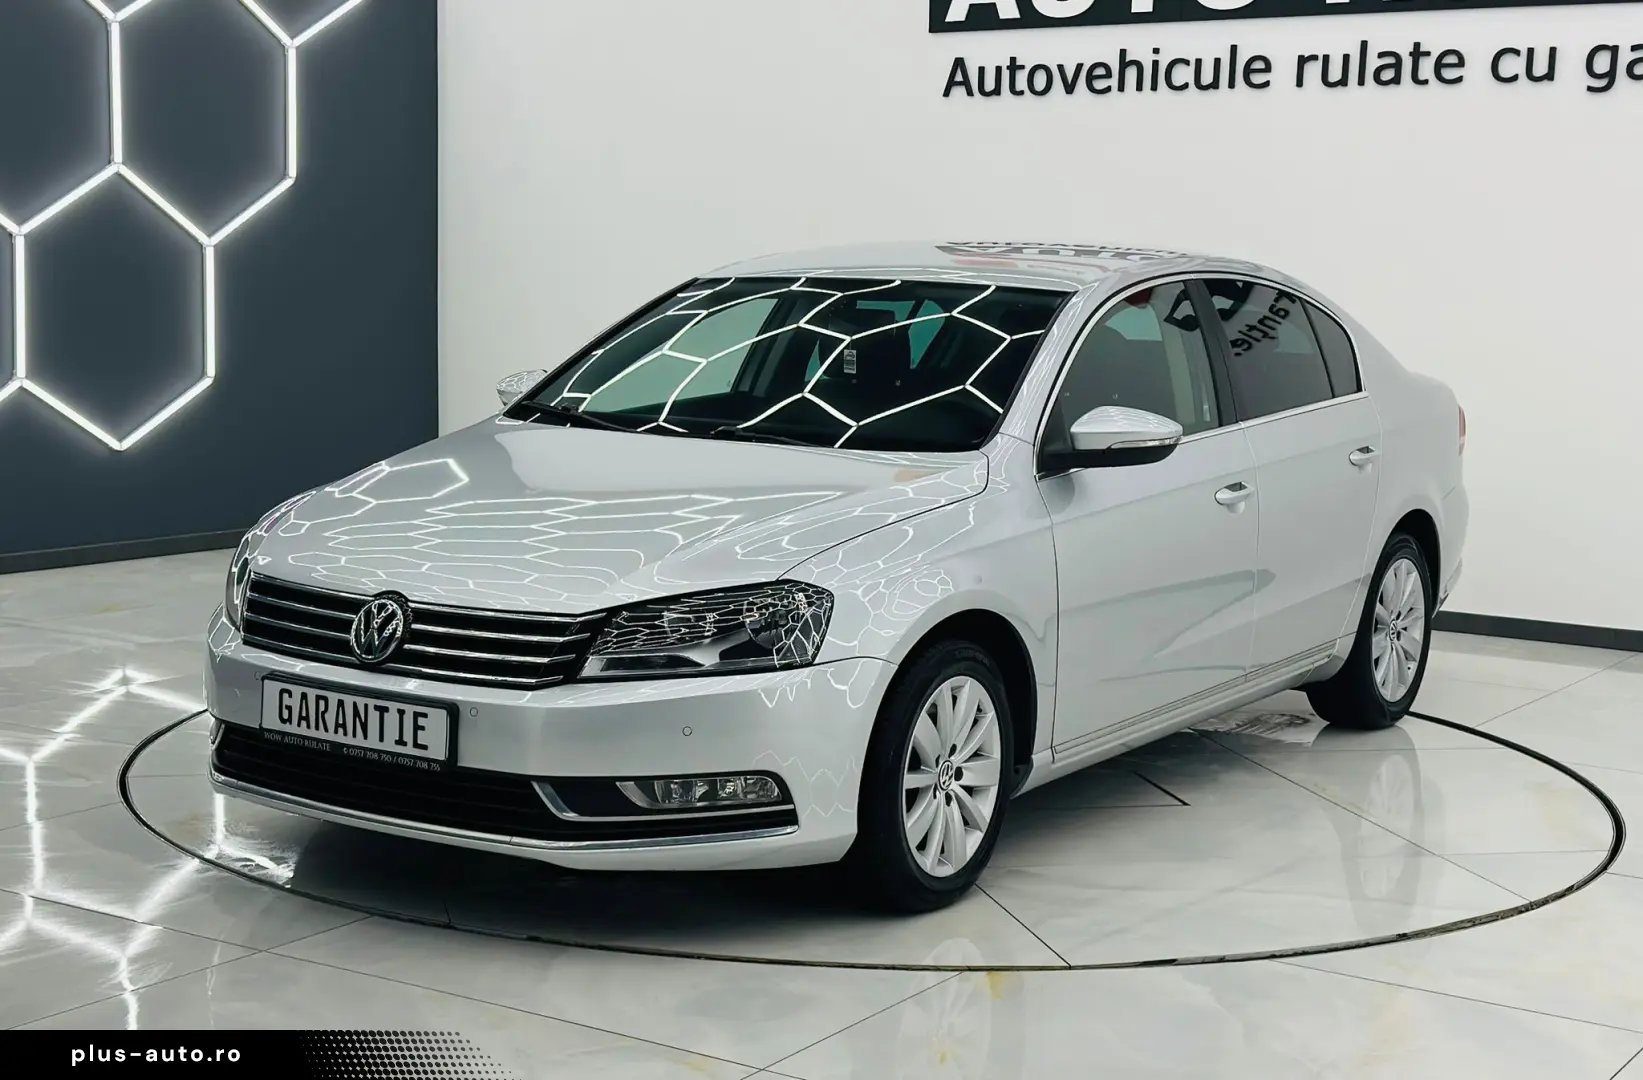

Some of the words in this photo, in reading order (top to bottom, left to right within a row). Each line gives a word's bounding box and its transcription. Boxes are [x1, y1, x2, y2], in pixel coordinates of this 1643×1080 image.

[942, 44, 1272, 98] Autovehicule
[1295, 39, 1466, 88] rulate
[1490, 45, 1558, 83] cu
[264, 731, 282, 744] WOW
[284, 735, 303, 746] AUTO
[304, 739, 331, 751] RULATE
[277, 687, 429, 751] GARANTIE
